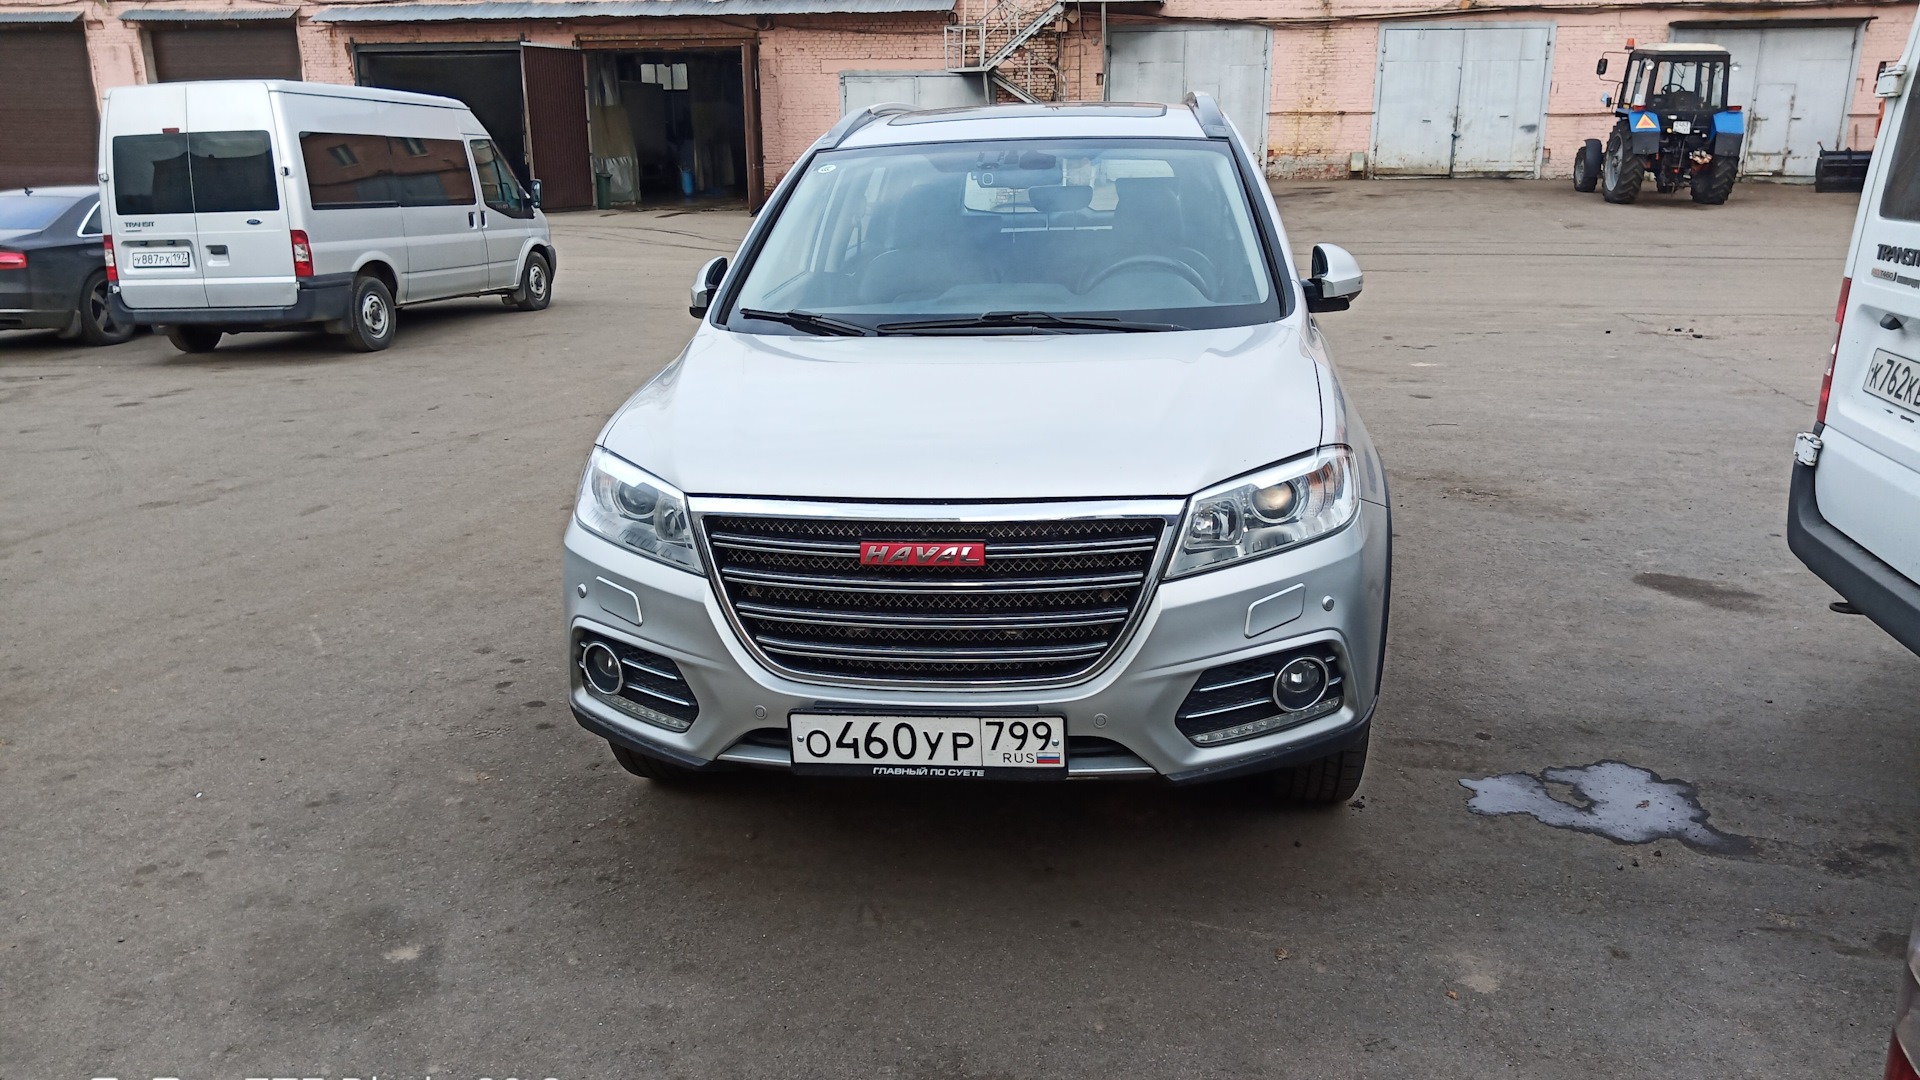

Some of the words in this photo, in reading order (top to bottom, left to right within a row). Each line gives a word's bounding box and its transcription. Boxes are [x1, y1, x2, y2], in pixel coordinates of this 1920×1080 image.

[173, 253, 185, 261] 197
[865, 545, 980, 563] HAVAL
[806, 721, 974, 761] О460УР
[985, 721, 1052, 751] 799
[1002, 752, 1035, 764] RUS
[873, 766, 928, 776] ГЛАВНЫЙ
[930, 767, 946, 776] ПО
[948, 768, 985, 777] СУЕТЕ
